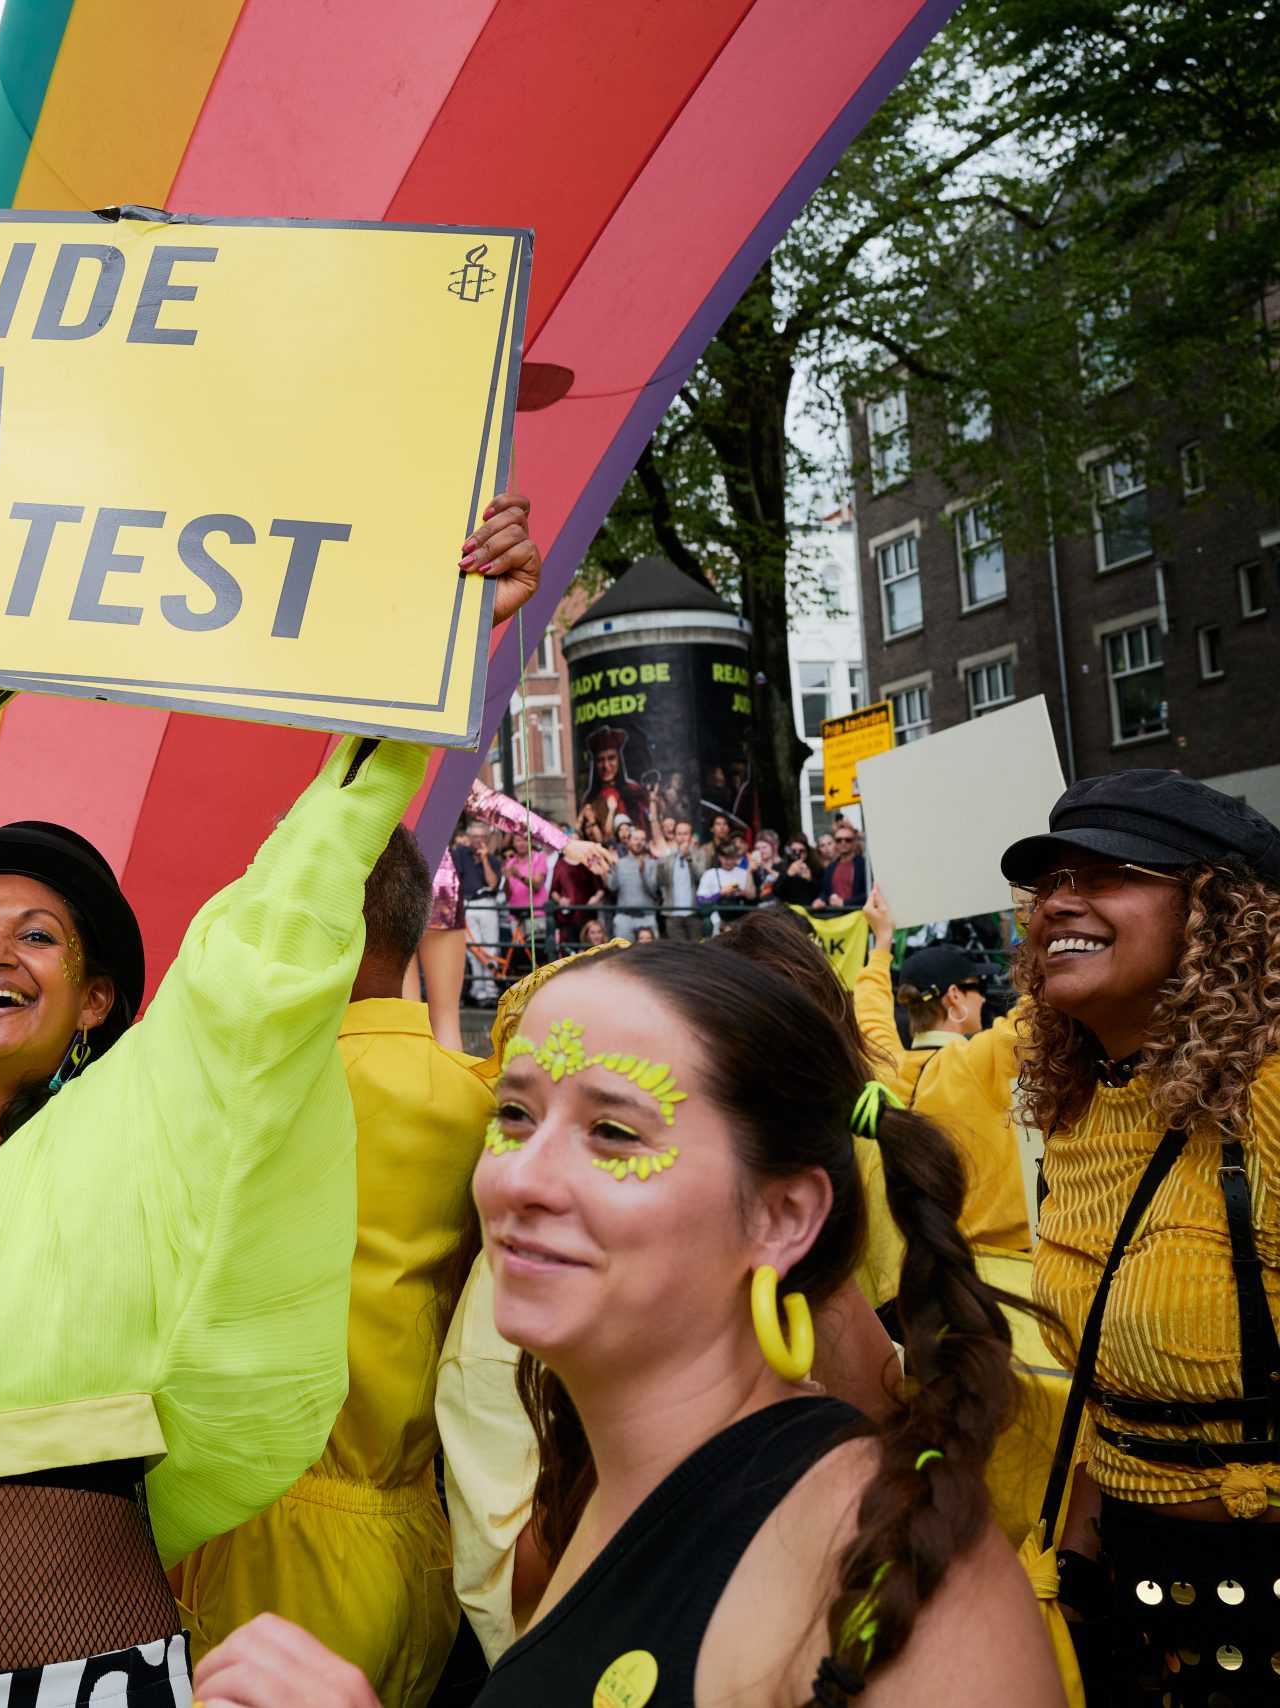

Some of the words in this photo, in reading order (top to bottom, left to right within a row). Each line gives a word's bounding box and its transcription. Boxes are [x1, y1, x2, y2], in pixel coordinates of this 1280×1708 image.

[606, 664, 638, 687] TO
[640, 663, 670, 683] BE
[575, 693, 647, 724] JUDGED?
